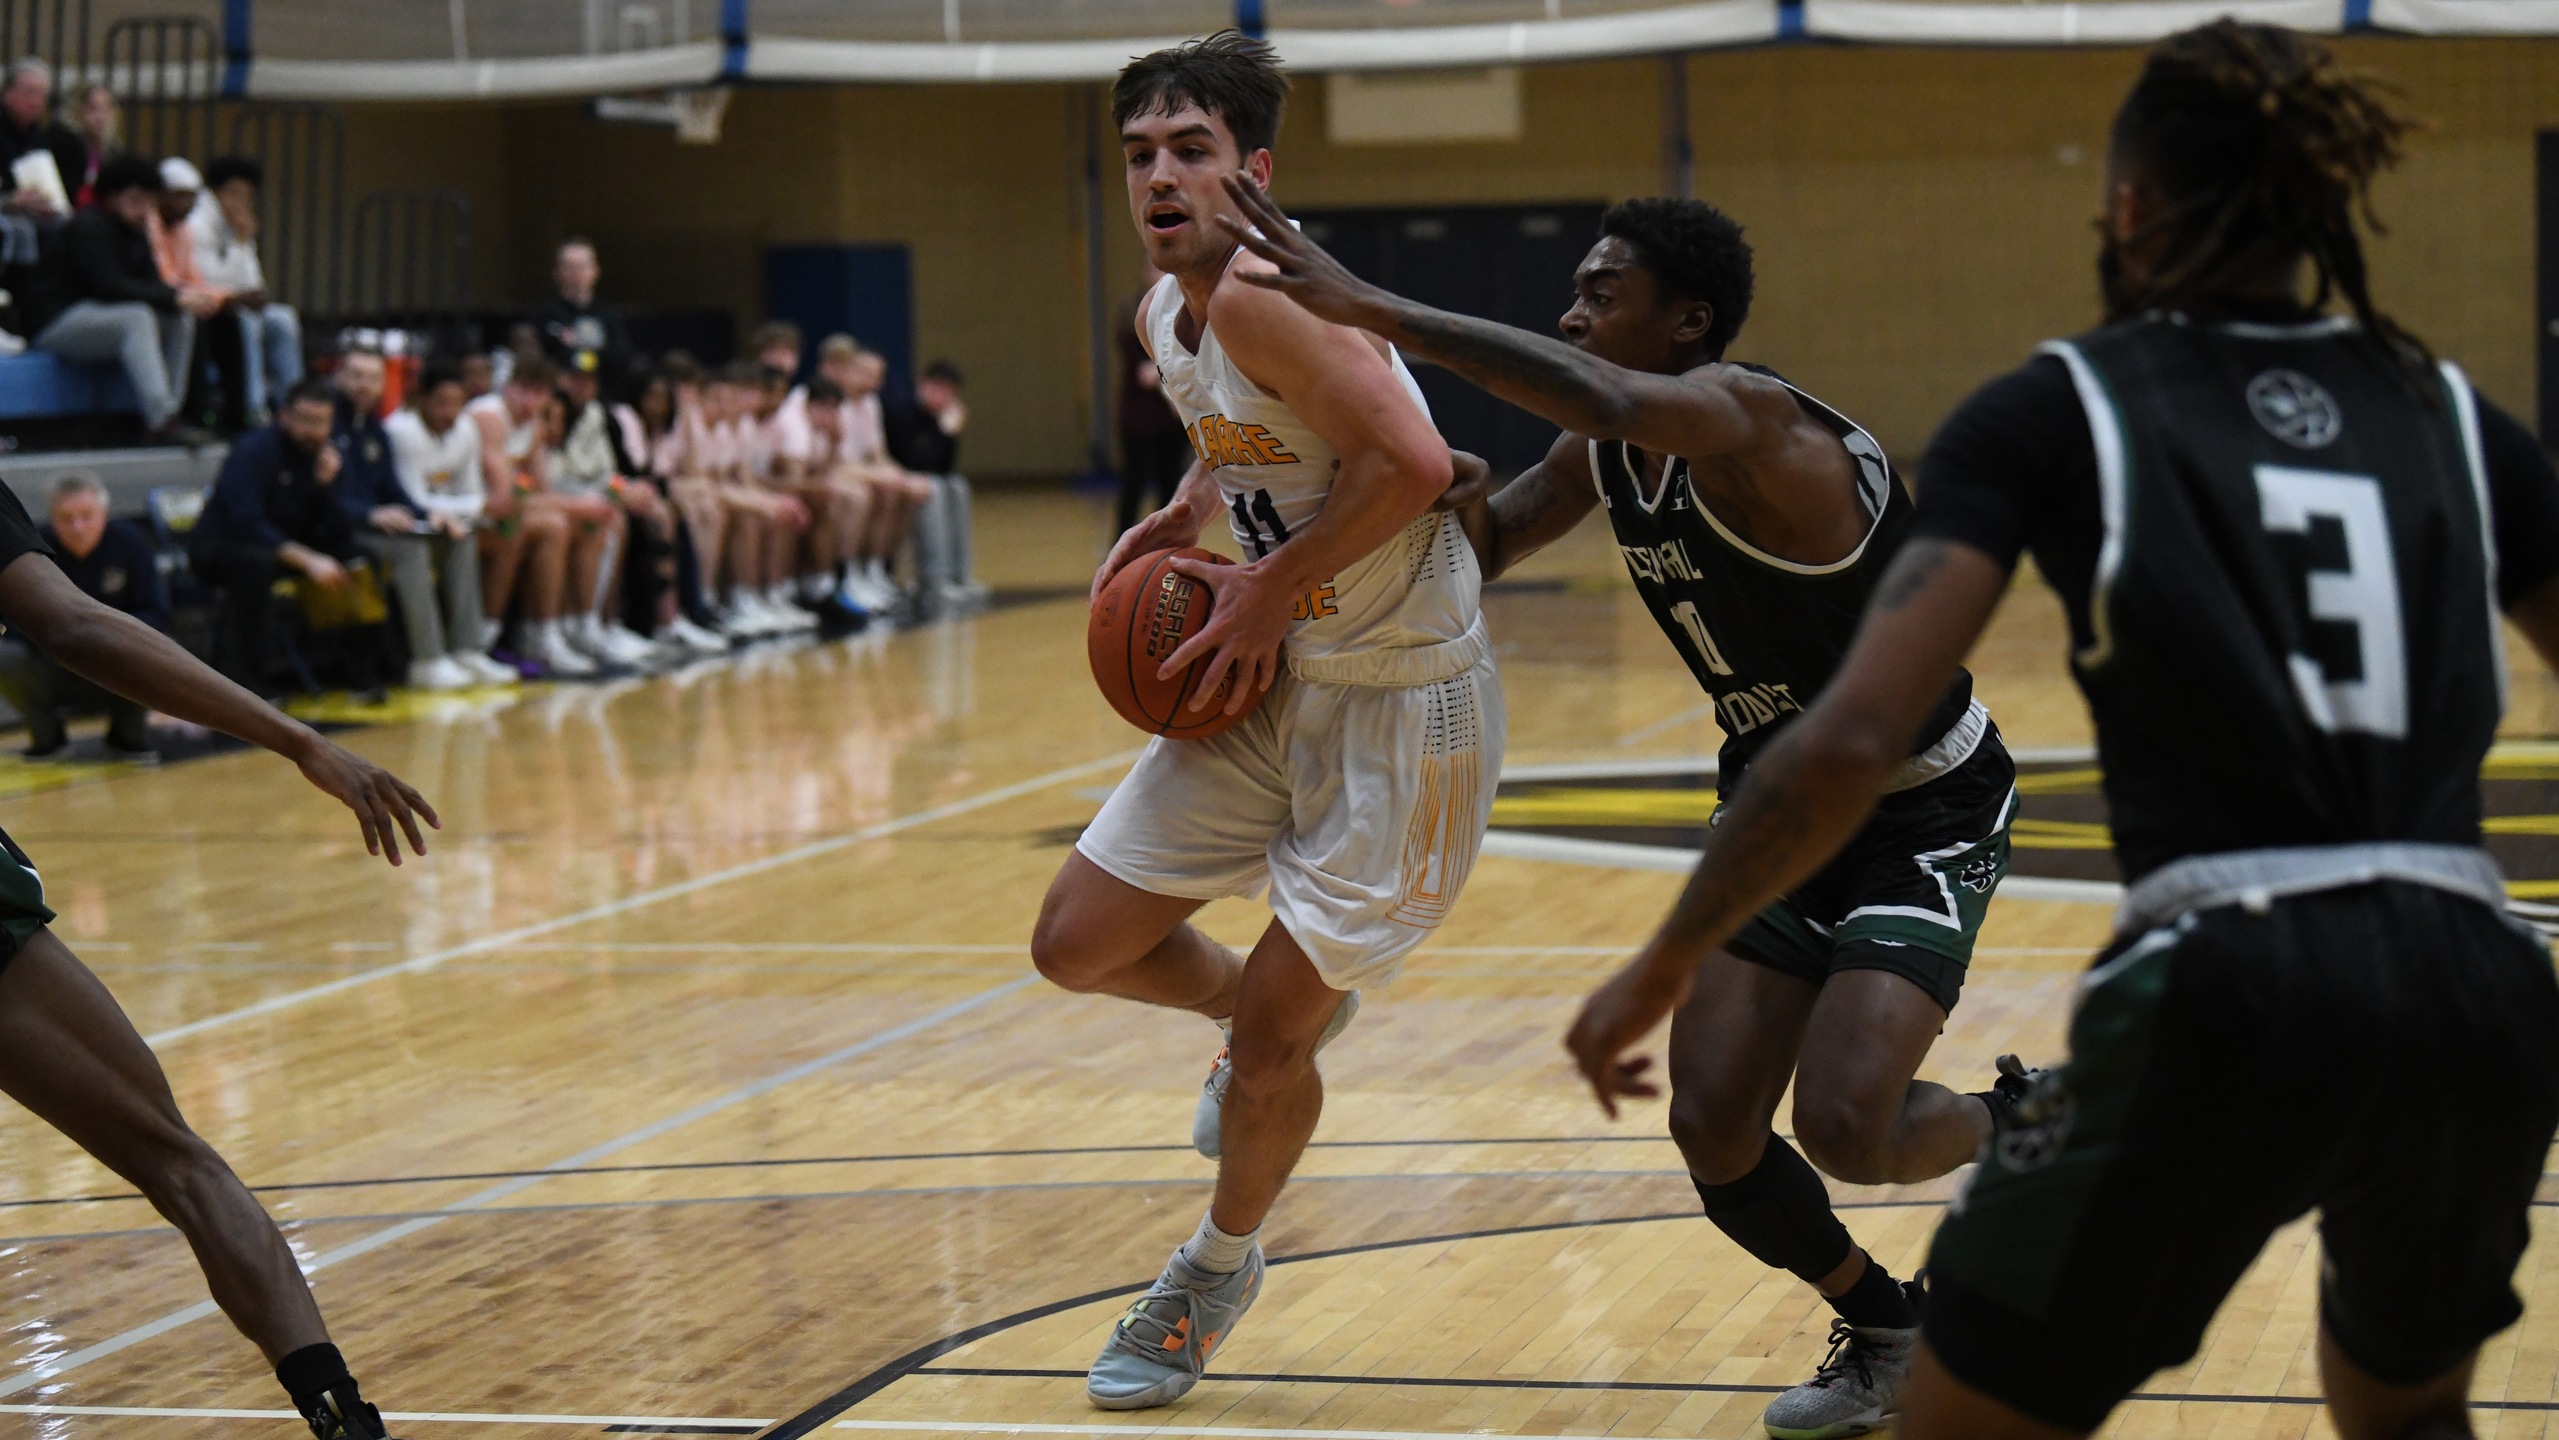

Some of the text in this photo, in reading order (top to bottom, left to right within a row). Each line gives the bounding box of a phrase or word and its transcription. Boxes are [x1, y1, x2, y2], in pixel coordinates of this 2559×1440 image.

[1187, 413, 1302, 473] LARKE
[1232, 488, 1291, 559] 11
[1157, 578, 1197, 664] EGAC
[2252, 463, 2411, 740] 3
